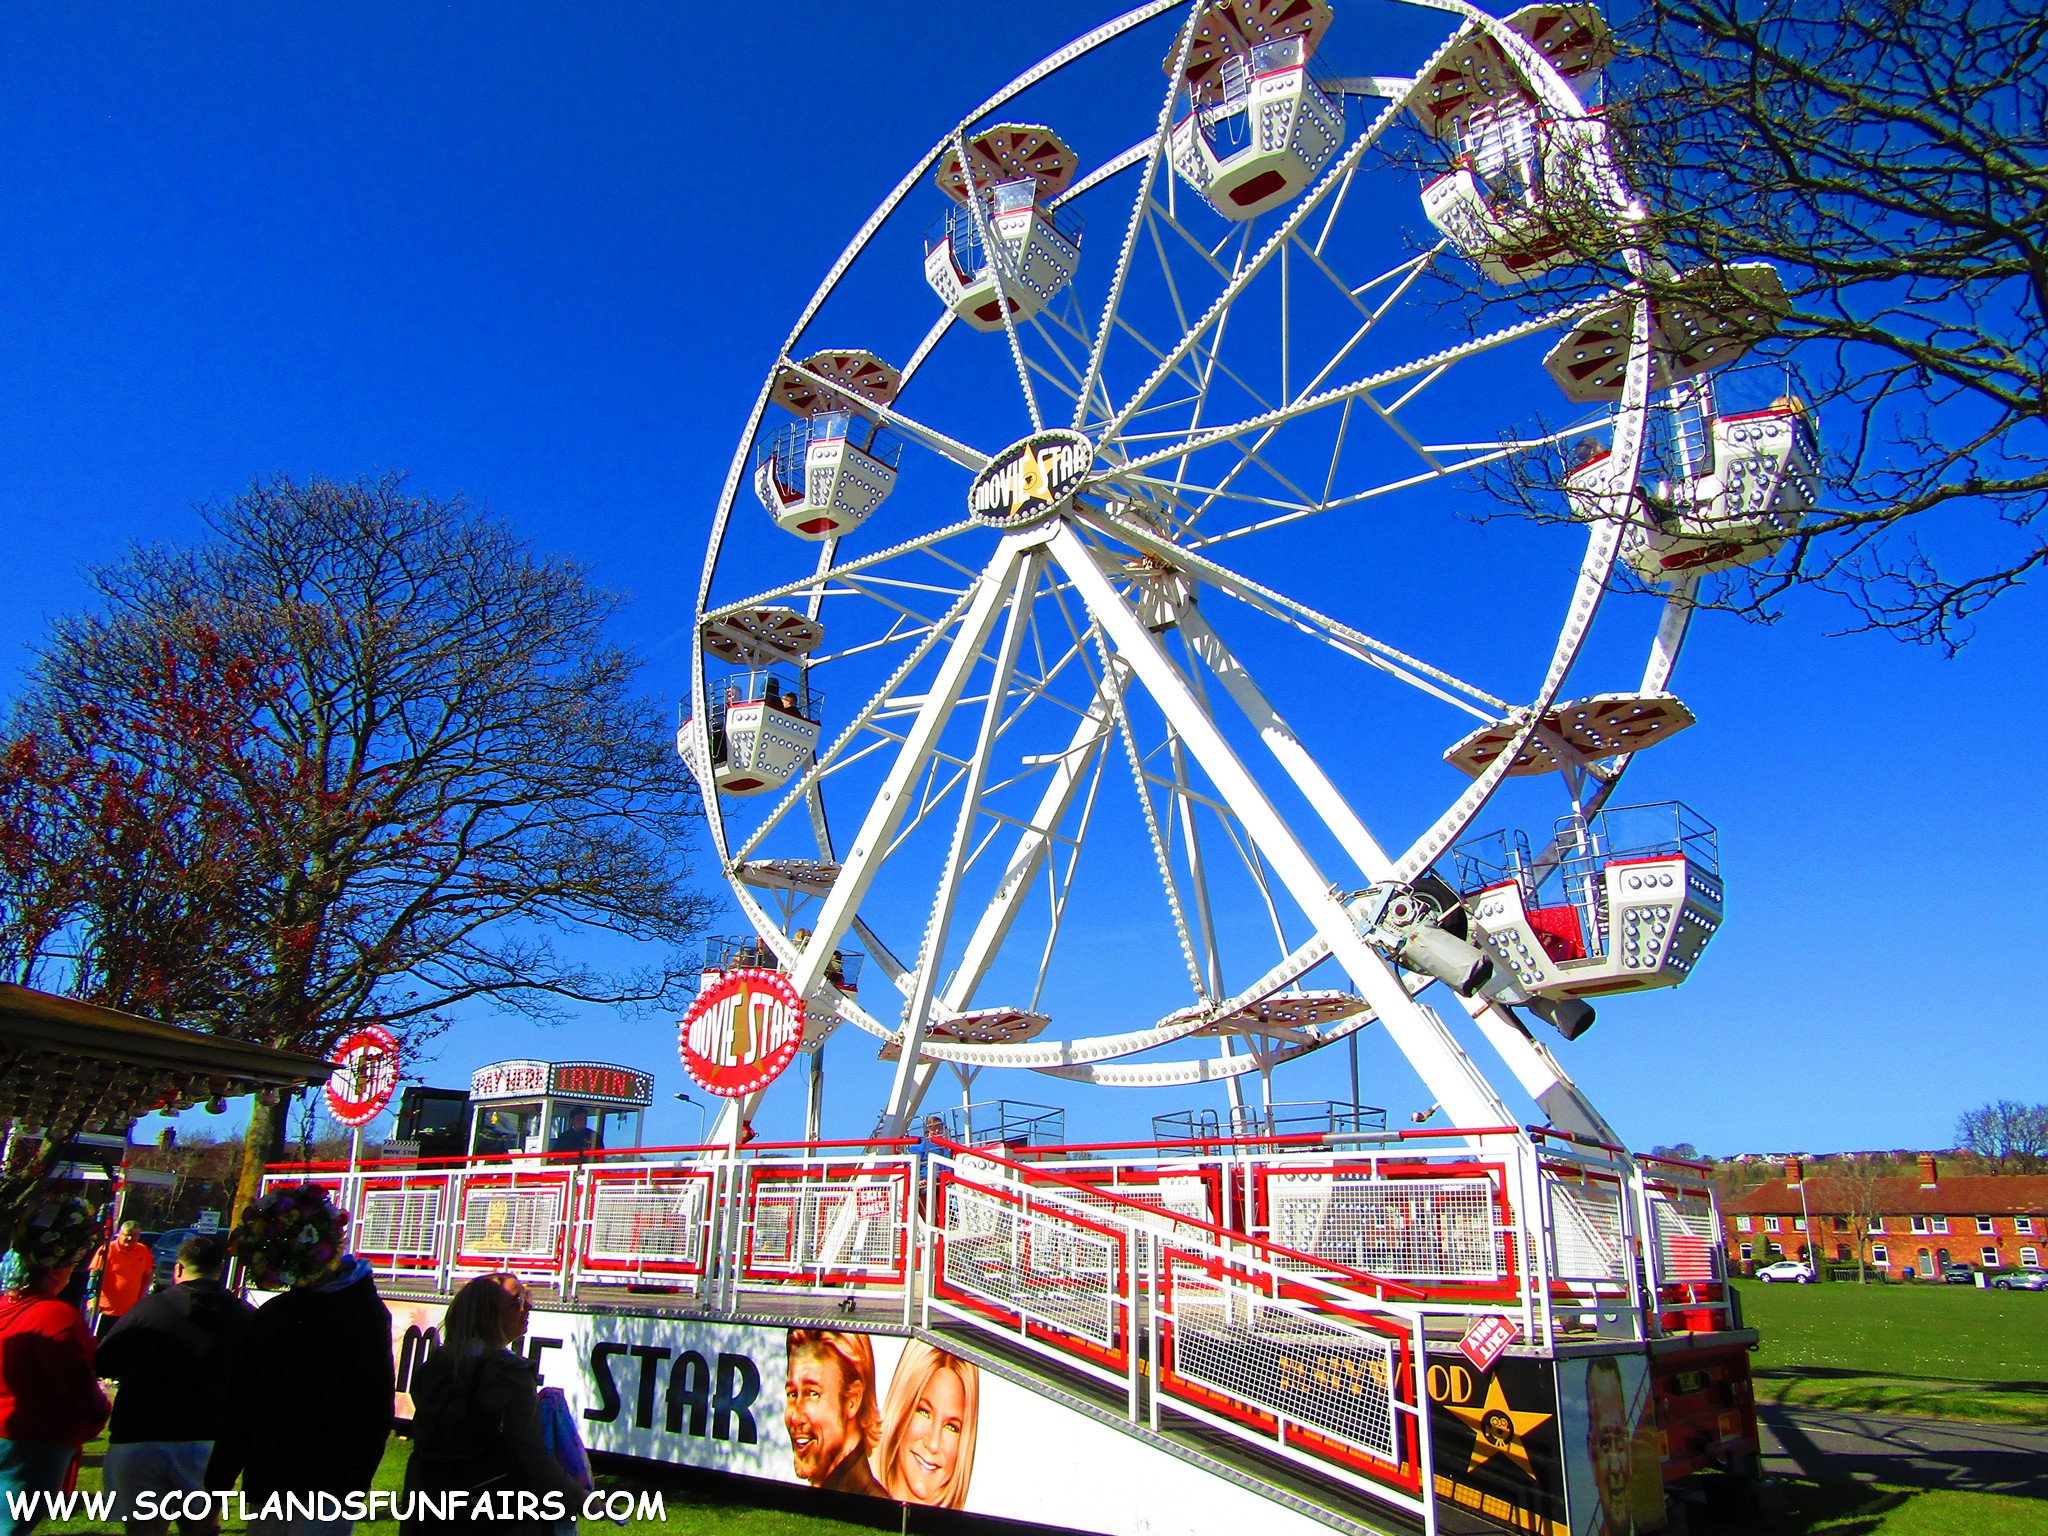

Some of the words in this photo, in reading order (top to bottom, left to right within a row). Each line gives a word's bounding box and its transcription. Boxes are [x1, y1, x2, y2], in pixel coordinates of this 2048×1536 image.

[975, 454, 1030, 511] MOVIE
[1037, 445, 1086, 496] STAR
[688, 993, 743, 1067] MOVIE
[743, 992, 795, 1065] STAR
[475, 1071, 502, 1094] PAY
[505, 1068, 545, 1092] HERE
[558, 1066, 646, 1099] IRVIN'S
[1466, 1316, 1499, 1351] ONLY
[1479, 1326, 1510, 1361] EXIT
[583, 1341, 762, 1445] STAR
